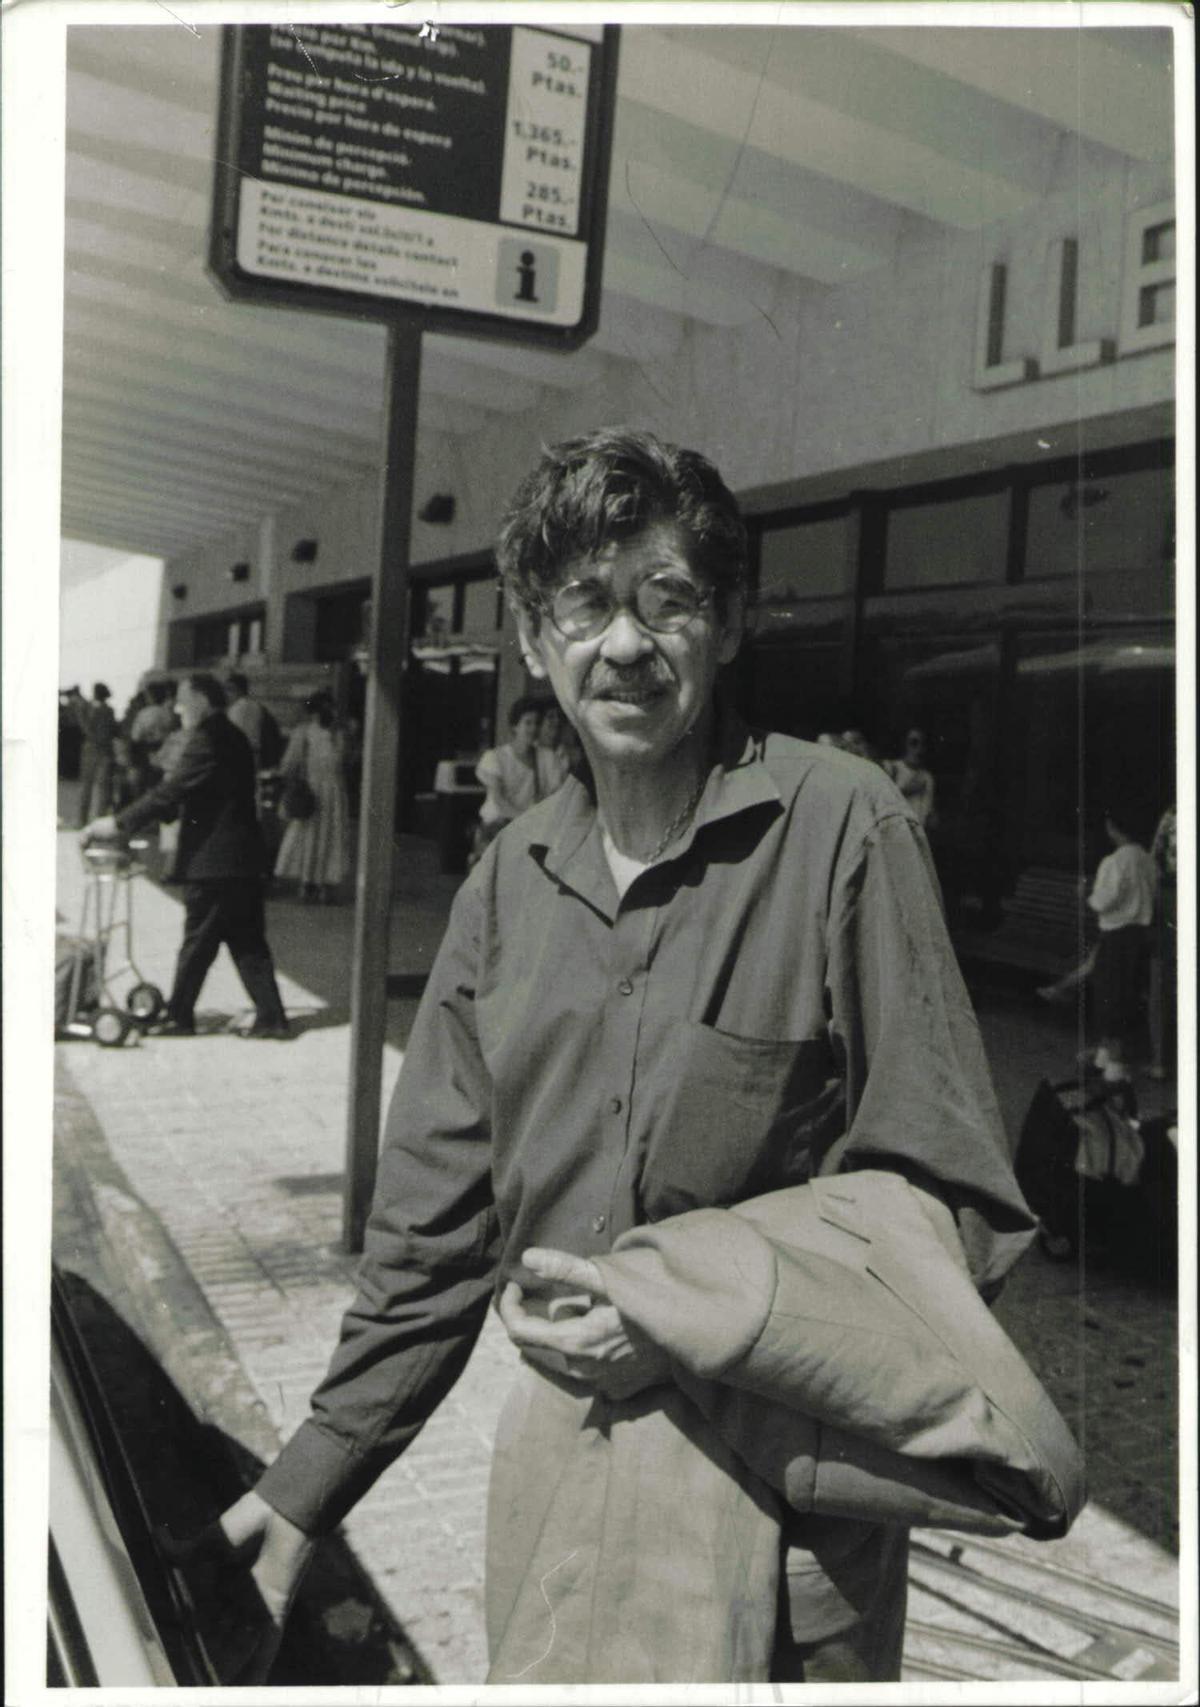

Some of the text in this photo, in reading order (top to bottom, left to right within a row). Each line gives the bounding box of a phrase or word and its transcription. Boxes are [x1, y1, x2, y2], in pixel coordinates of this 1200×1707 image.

[265, 97, 314, 120] Precio
[344, 113, 380, 134] hora
[381, 122, 401, 138] de
[314, 135, 334, 152] de
[321, 172, 341, 188] de
